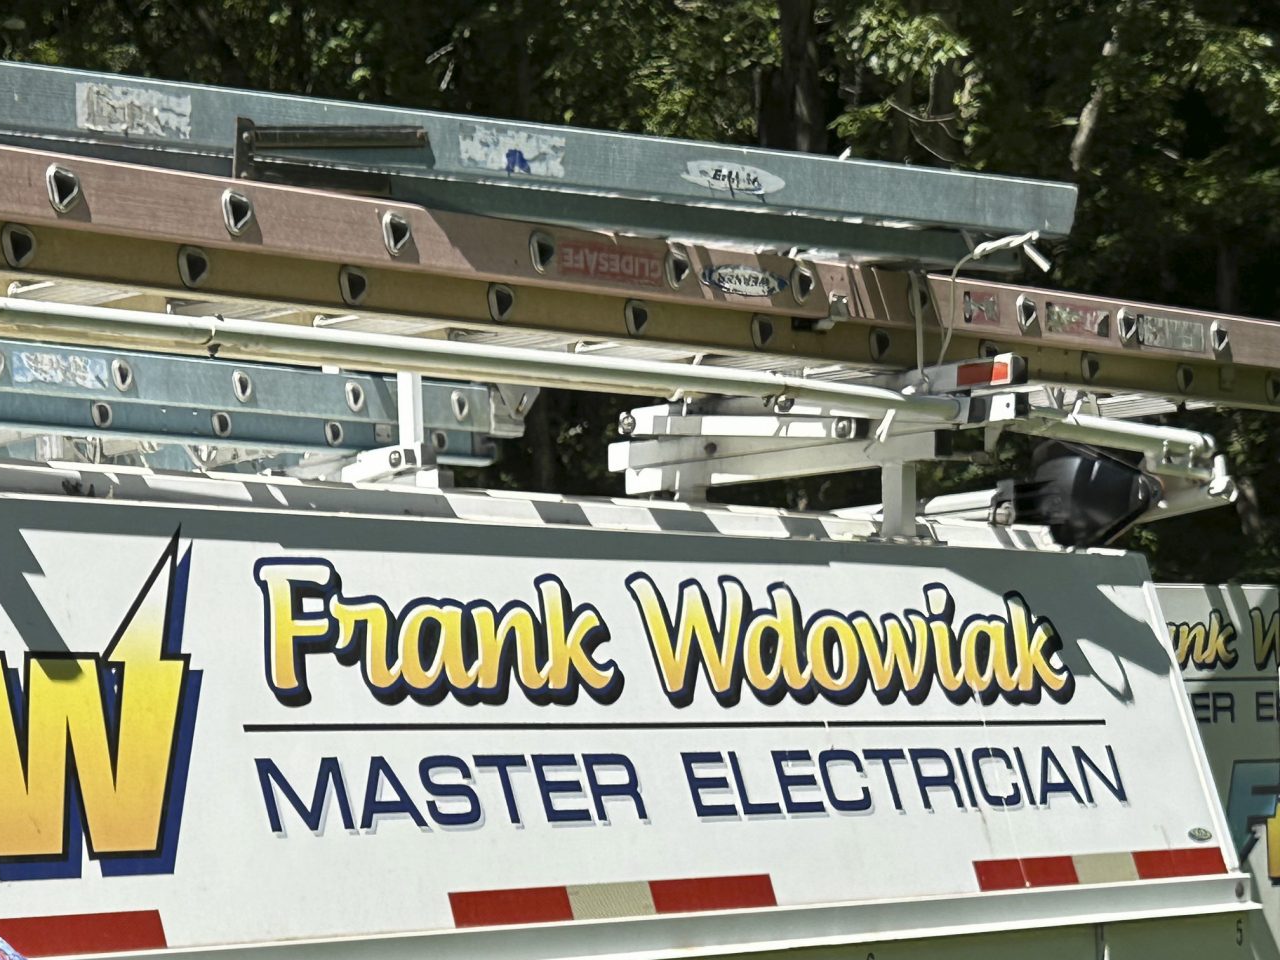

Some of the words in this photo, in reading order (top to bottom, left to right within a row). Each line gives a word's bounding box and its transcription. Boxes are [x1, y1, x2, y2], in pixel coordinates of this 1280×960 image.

[562, 247, 663, 278] GLIDESAFE
[253, 557, 624, 708] Frank
[625, 571, 1076, 709] Wdowiak
[254, 753, 651, 838] MASTER
[680, 745, 1130, 823] ELECTRICIAN
[1235, 918, 1243, 946] 5
